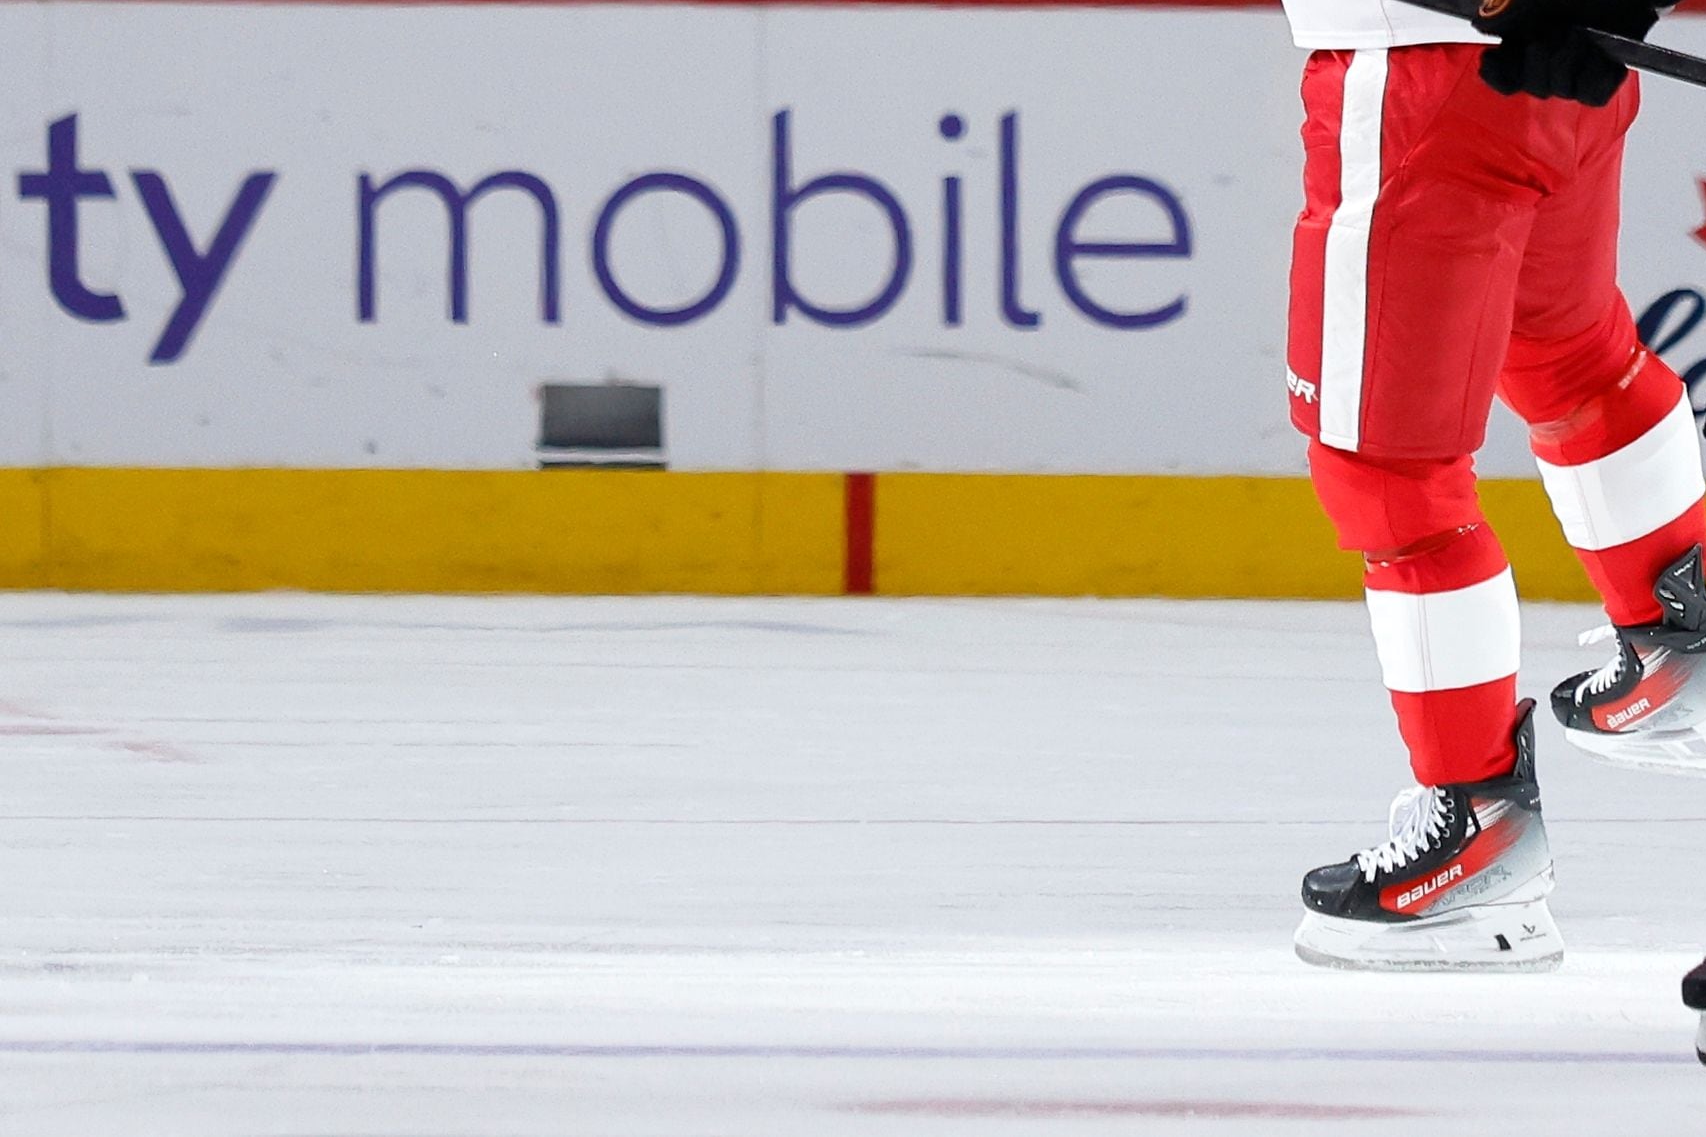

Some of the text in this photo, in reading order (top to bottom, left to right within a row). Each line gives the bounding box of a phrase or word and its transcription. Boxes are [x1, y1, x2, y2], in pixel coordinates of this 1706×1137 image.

[17, 109, 1193, 365] ty mobile
[1606, 697, 1652, 730] BAUER
[1397, 864, 1463, 909] BAUER
